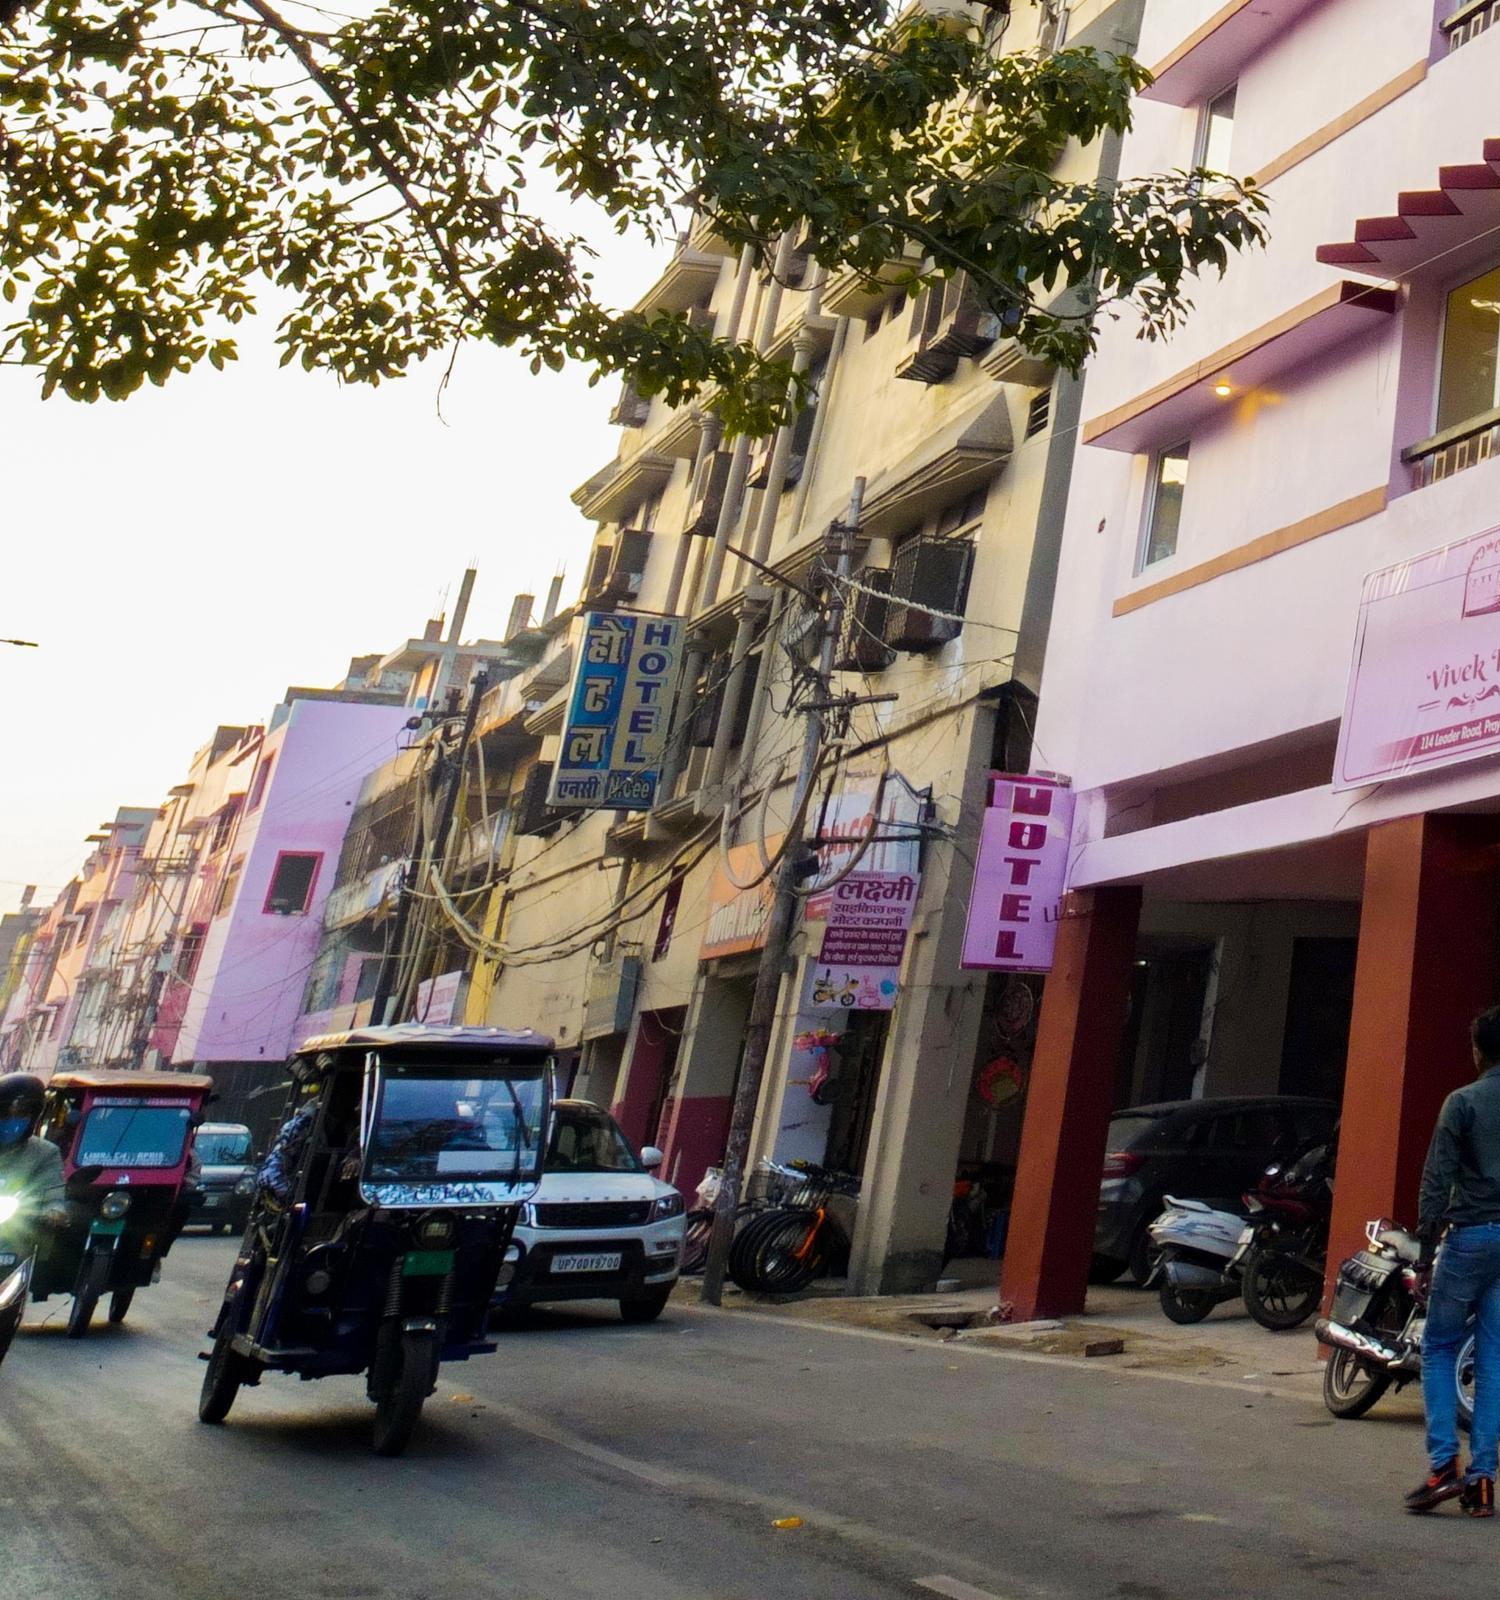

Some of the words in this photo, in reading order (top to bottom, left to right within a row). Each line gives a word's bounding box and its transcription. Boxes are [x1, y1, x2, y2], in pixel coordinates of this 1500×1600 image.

[1426, 655, 1487, 691] Vivek
[625, 623, 672, 763] HOTEL
[1435, 729, 1460, 745] Leader
[837, 875, 917, 902] लक्ष्मी
